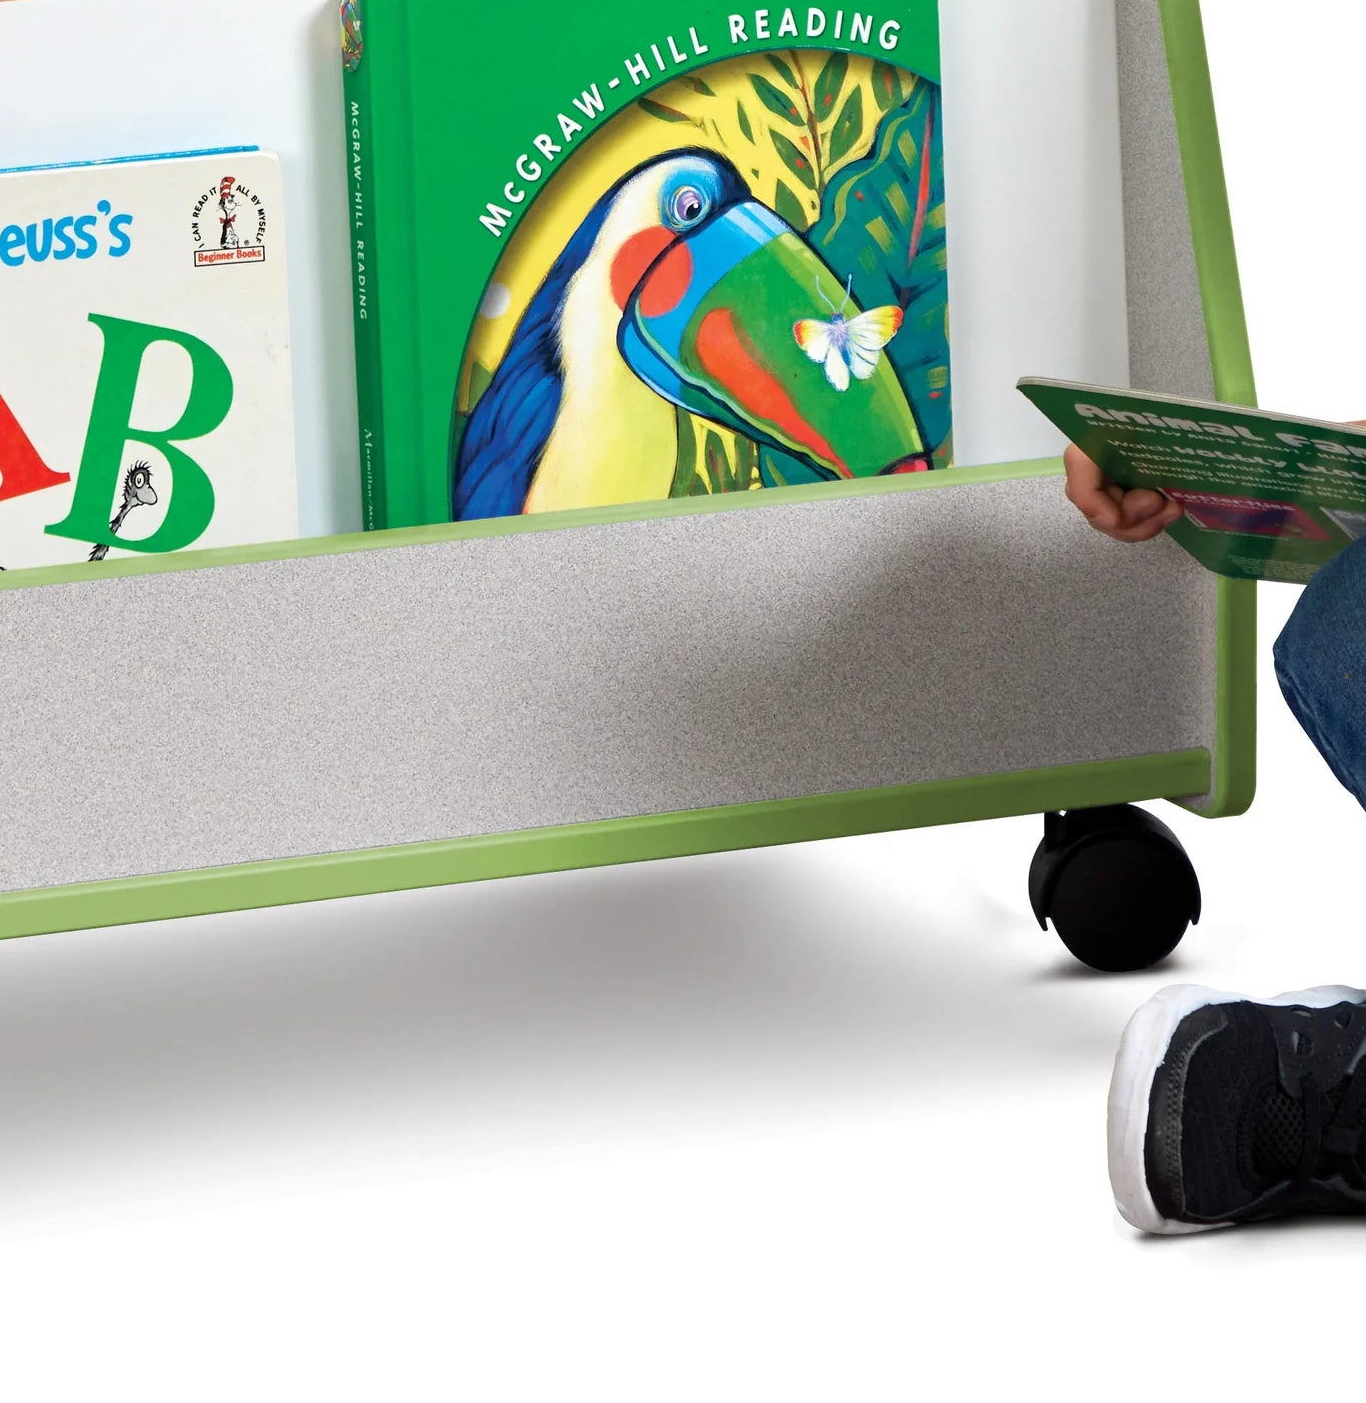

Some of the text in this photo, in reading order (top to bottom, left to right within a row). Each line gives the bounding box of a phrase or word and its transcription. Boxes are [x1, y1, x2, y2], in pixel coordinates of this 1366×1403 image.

[728, 6, 903, 51] READING
[209, 186, 217, 196] IT
[236, 184, 250, 197] ALL
[250, 195, 262, 206] BY
[192, 194, 209, 218] READ
[192, 222, 202, 242] CAN
[255, 208, 266, 244] MYSELF
[197, 248, 262, 263] Beginner Books
[357, 240, 368, 320] READING
[43, 312, 235, 554] B
[1074, 402, 1265, 442] Animal
[1105, 438, 1172, 453] Watch
[1172, 443, 1291, 469] wobbly
